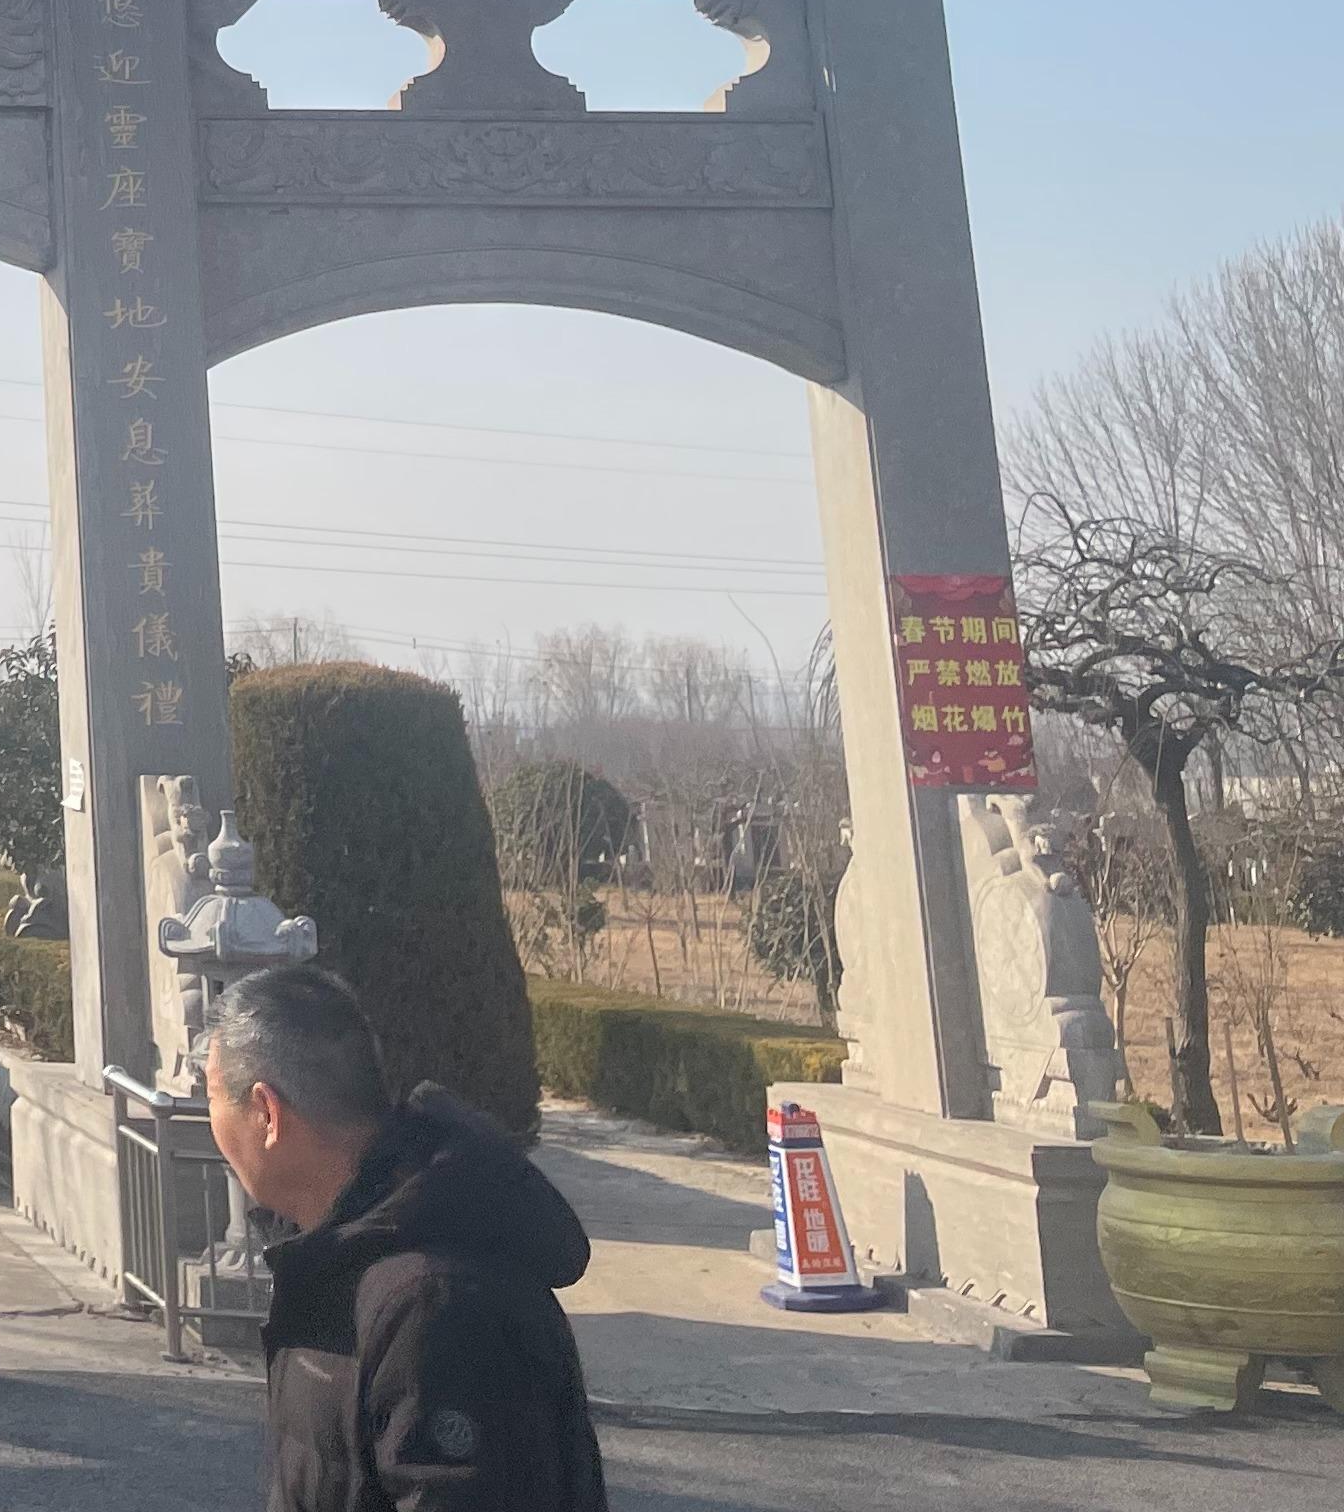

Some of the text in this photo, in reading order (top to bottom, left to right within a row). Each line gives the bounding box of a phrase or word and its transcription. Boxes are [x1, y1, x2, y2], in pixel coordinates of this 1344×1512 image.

[901, 616, 1018, 644] 春节期间
[906, 659, 1022, 687] 严禁燃放
[911, 704, 1025, 733] 烟花爆竹
